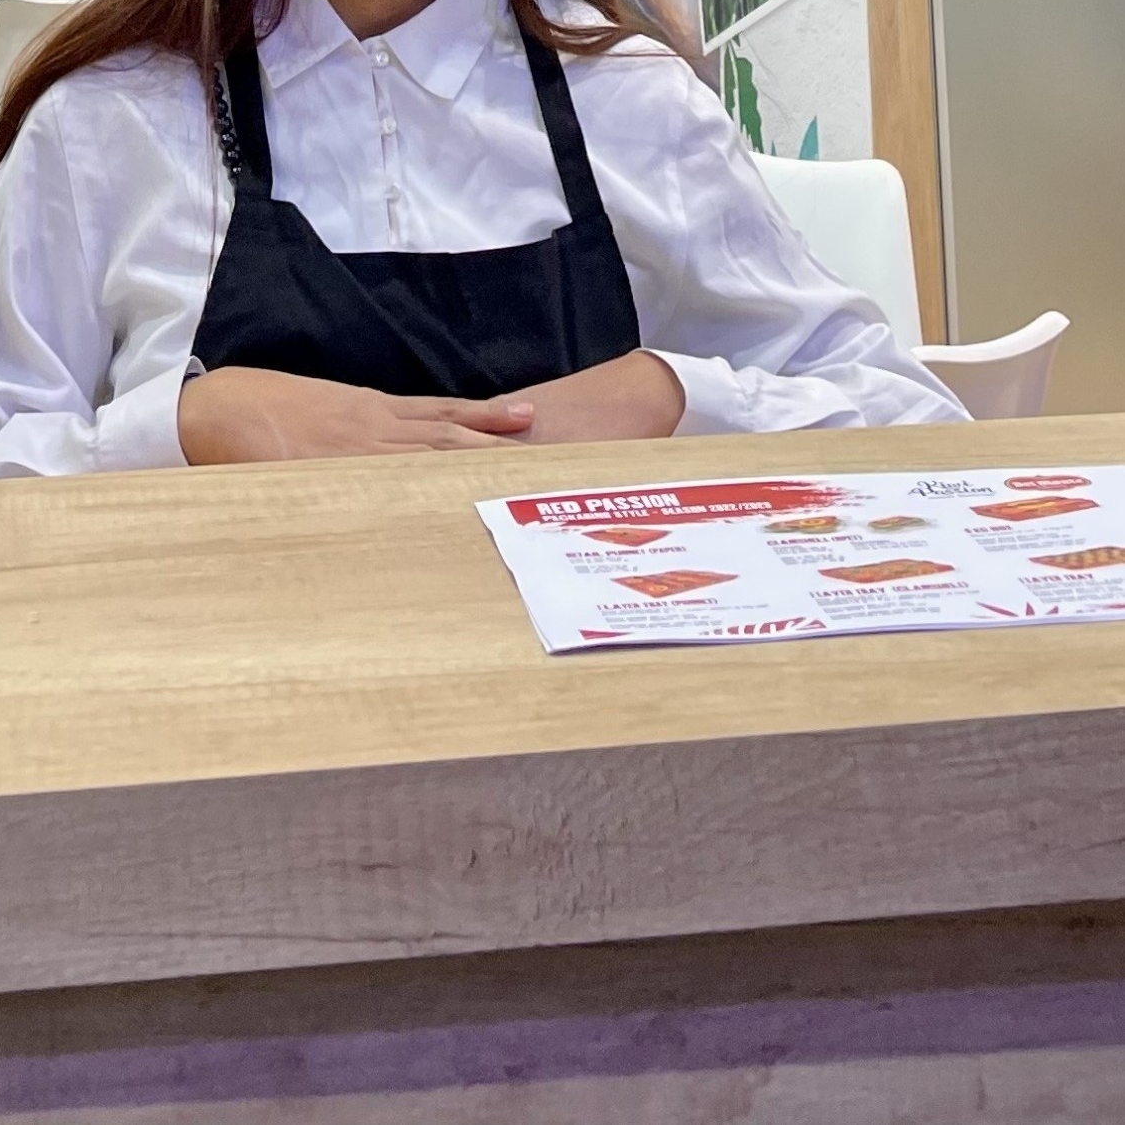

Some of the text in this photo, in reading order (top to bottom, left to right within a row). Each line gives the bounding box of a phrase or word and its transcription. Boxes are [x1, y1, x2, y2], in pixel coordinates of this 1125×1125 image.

[536, 493, 680, 517] RED PASSION
[613, 508, 649, 519] STYLE
